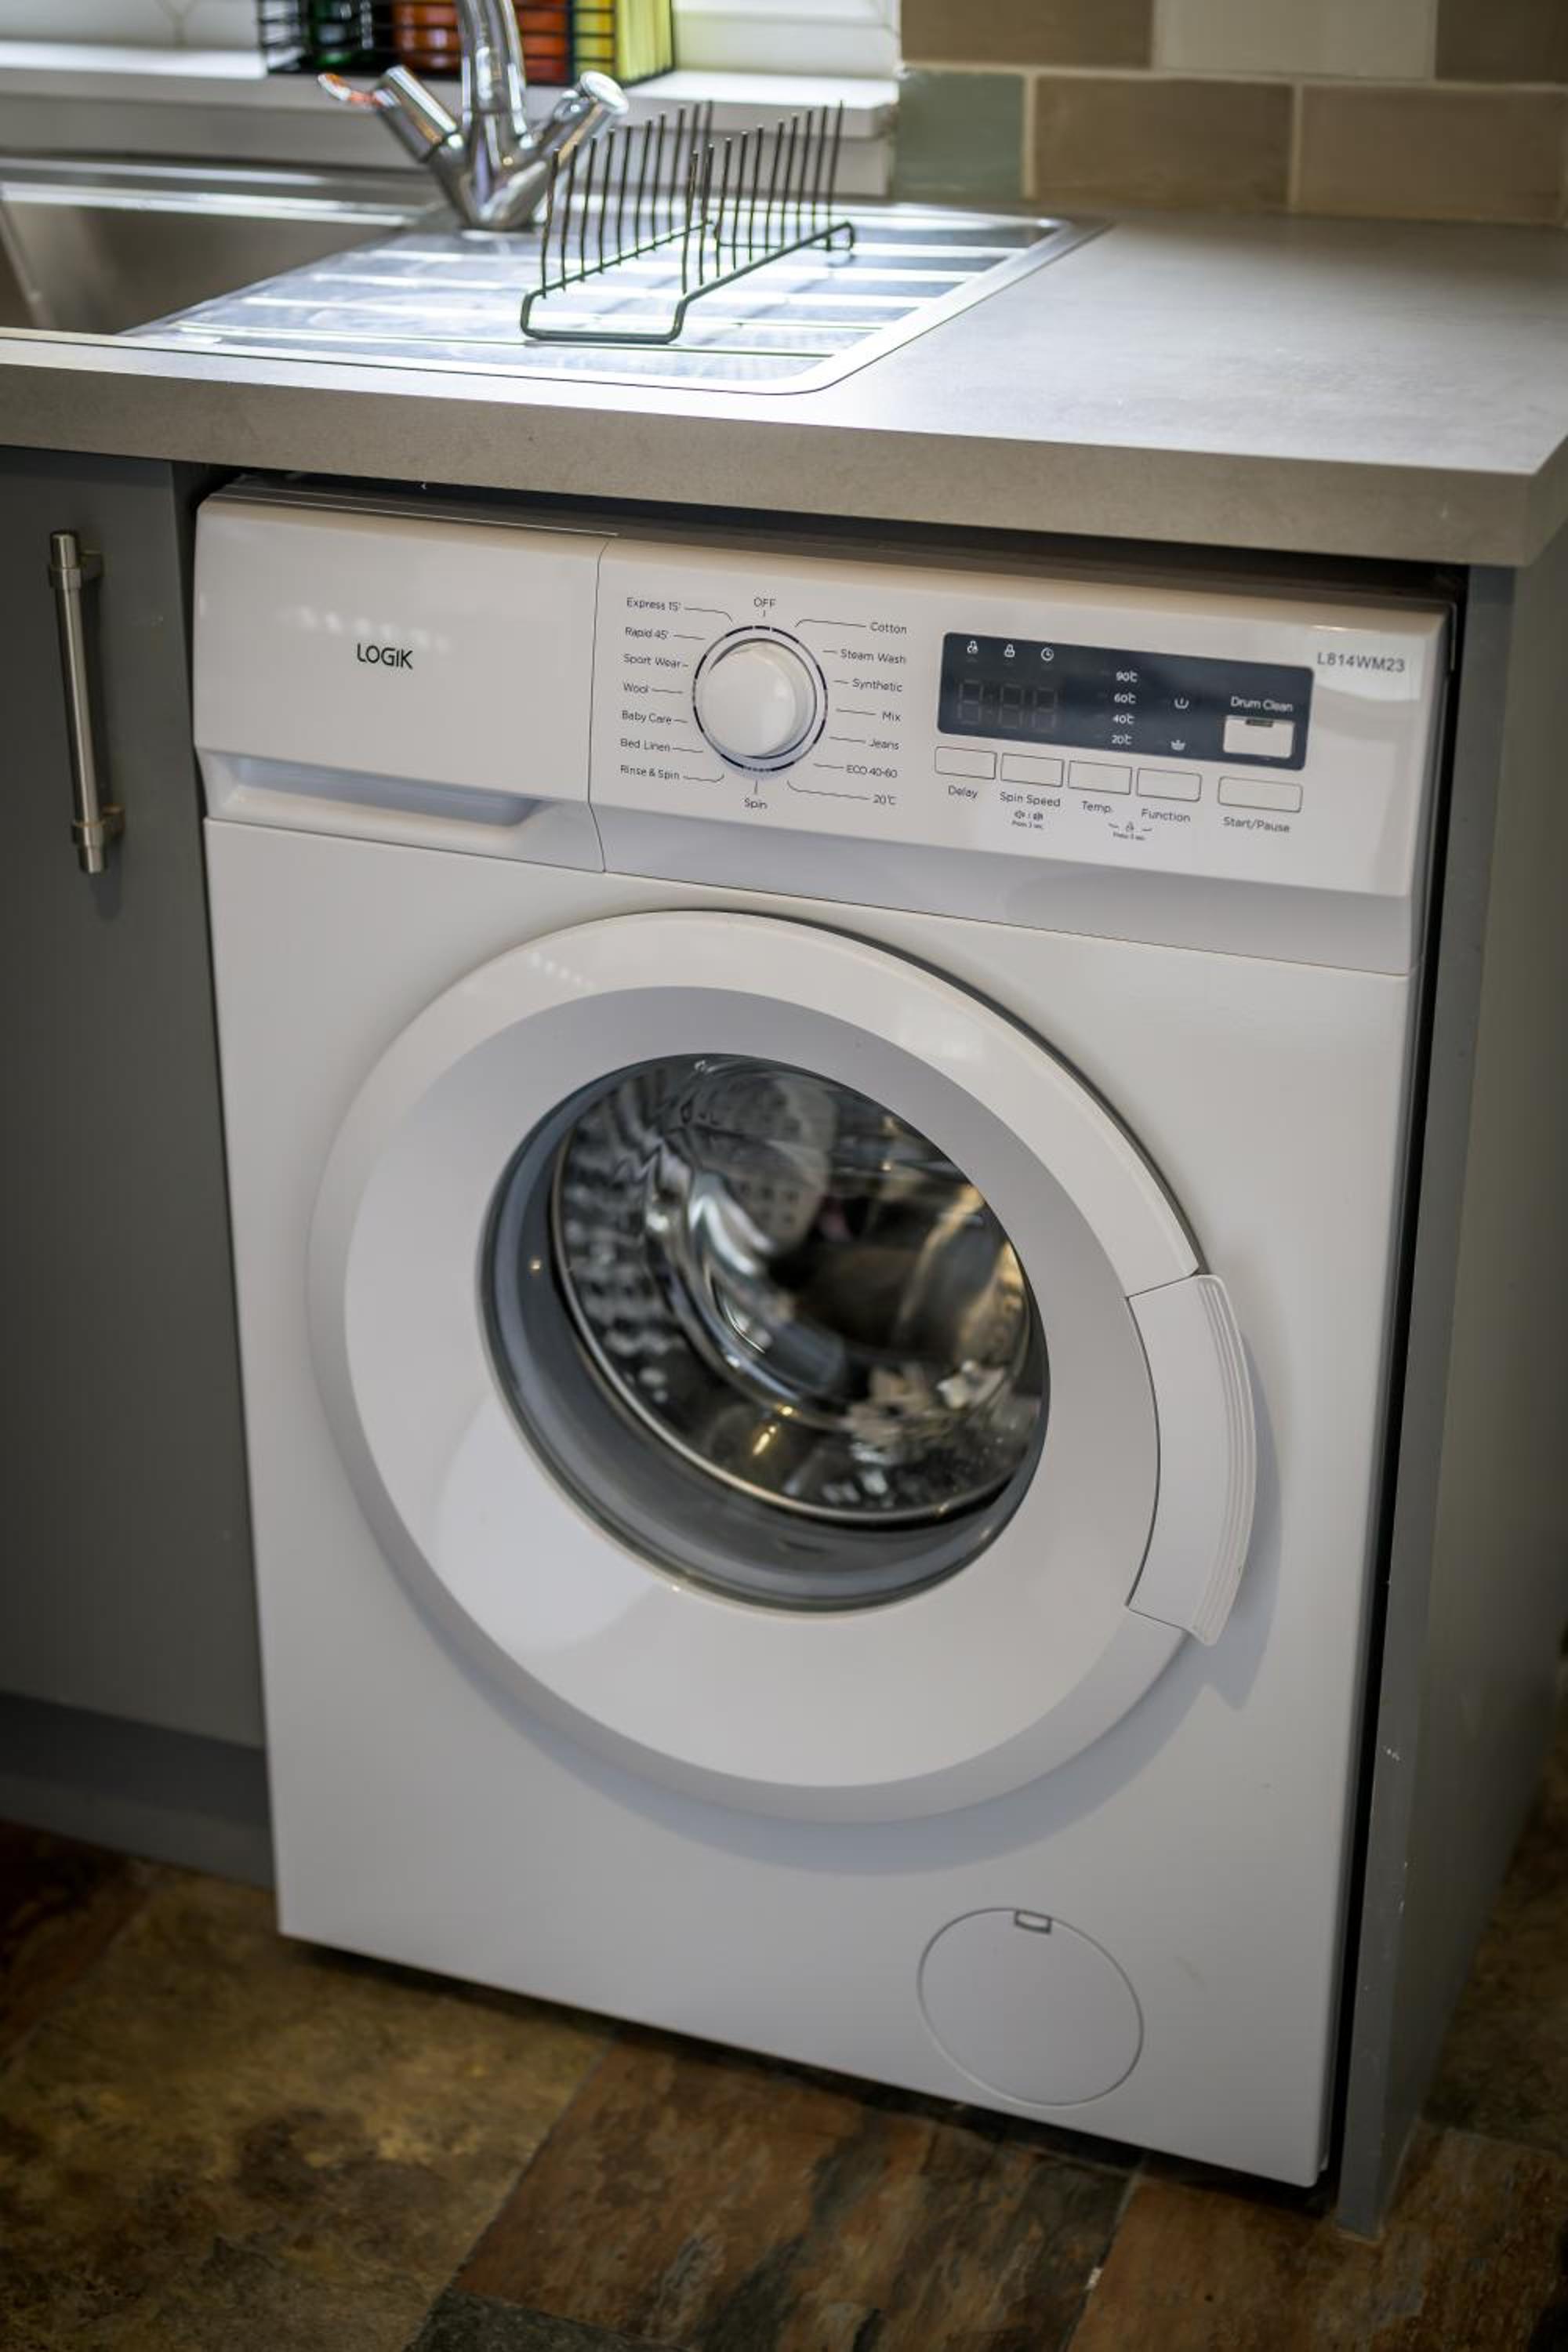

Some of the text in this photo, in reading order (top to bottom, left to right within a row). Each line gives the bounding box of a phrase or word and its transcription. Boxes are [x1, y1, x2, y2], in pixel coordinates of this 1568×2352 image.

[626, 597, 666, 611] Express
[753, 597, 776, 608] OFF
[625, 626, 653, 638] Rapid
[870, 622, 907, 633] Cotton
[357, 643, 413, 670] LOGIK
[623, 652, 681, 668] Sport Wear
[840, 648, 906, 664] Steam Wash
[1317, 652, 1406, 673] L814WM23
[623, 682, 649, 694] Wool
[852, 678, 903, 692] Synthetic
[1230, 695, 1293, 712] Drum Clean
[622, 710, 672, 724] Baby Care
[881, 710, 901, 722] Mix
[620, 738, 670, 752] Bed Linen
[869, 739, 899, 750] Jeans
[619, 764, 680, 780] Rinse & Spin
[846, 764, 898, 779] ECO 40-60
[948, 785, 978, 799] Delay
[744, 797, 768, 810] Spin
[1000, 792, 1061, 808] Spin Speed
[1141, 808, 1191, 823] Function
[1224, 817, 1290, 833] Start/Pause
